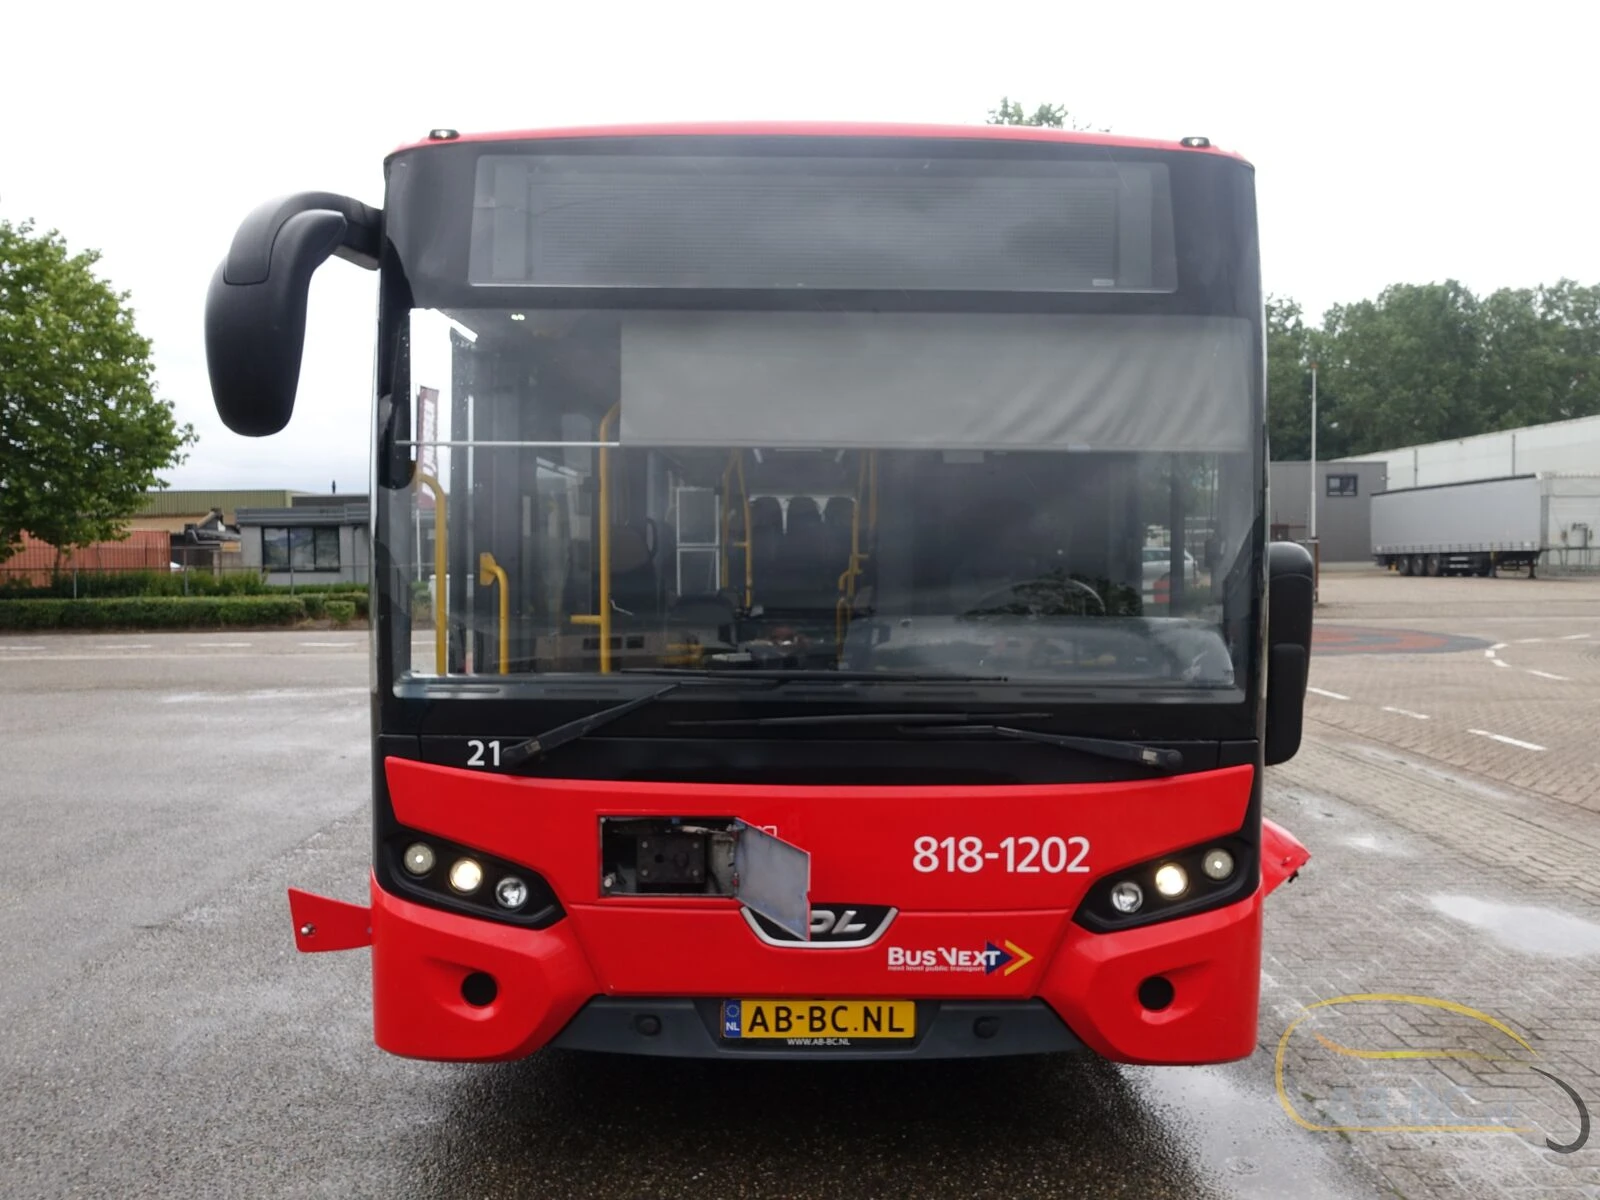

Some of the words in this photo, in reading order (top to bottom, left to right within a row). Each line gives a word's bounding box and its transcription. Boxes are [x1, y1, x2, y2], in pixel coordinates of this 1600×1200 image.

[466, 740, 500, 766] 21
[912, 836, 1091, 873] 818-1202
[810, 909, 867, 934] DL
[725, 1021, 740, 1032] NL
[748, 1005, 904, 1033] AB-BC.NL
